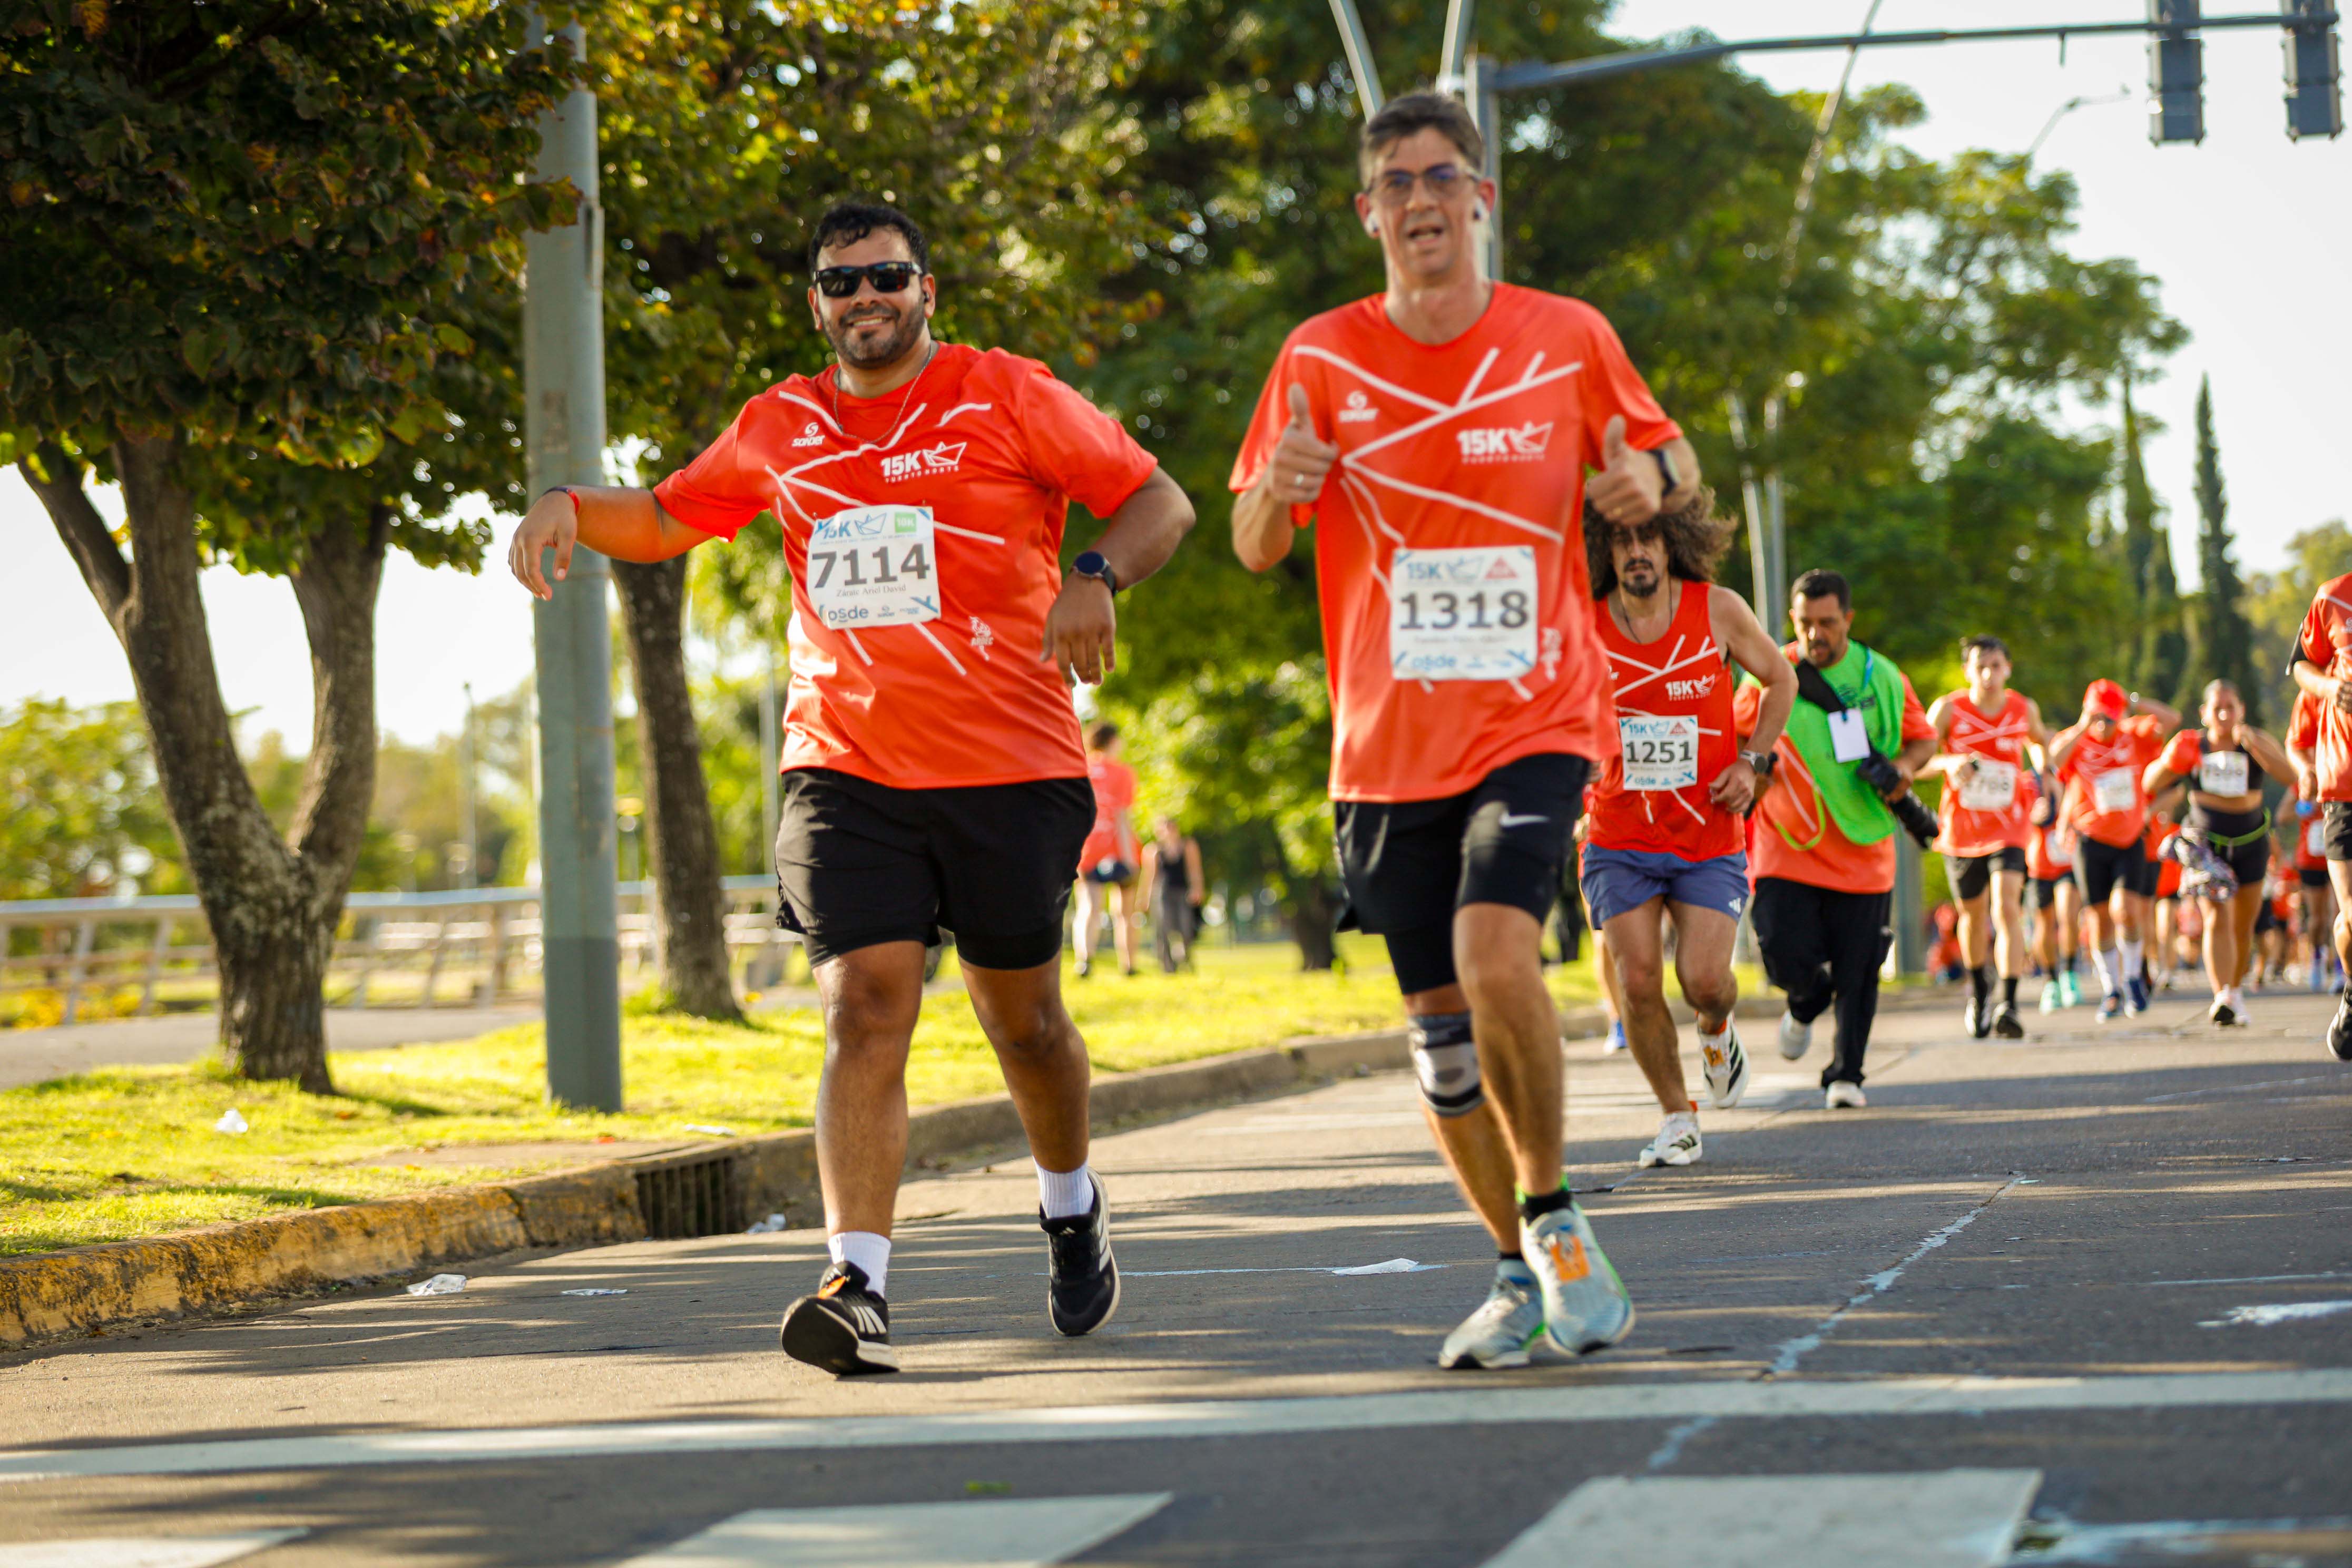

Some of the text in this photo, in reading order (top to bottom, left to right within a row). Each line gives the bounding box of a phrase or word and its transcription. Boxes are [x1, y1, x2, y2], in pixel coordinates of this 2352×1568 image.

[1456, 428, 1508, 455] 15K
[880, 450, 922, 476] 15K
[812, 543, 930, 589] 7114
[1407, 562, 1442, 580] 15K
[883, 583, 907, 593] David
[828, 605, 869, 621] osde
[1399, 590, 1528, 630] 1318
[1665, 680, 1694, 696] 15K
[1626, 740, 1693, 763] 1251
